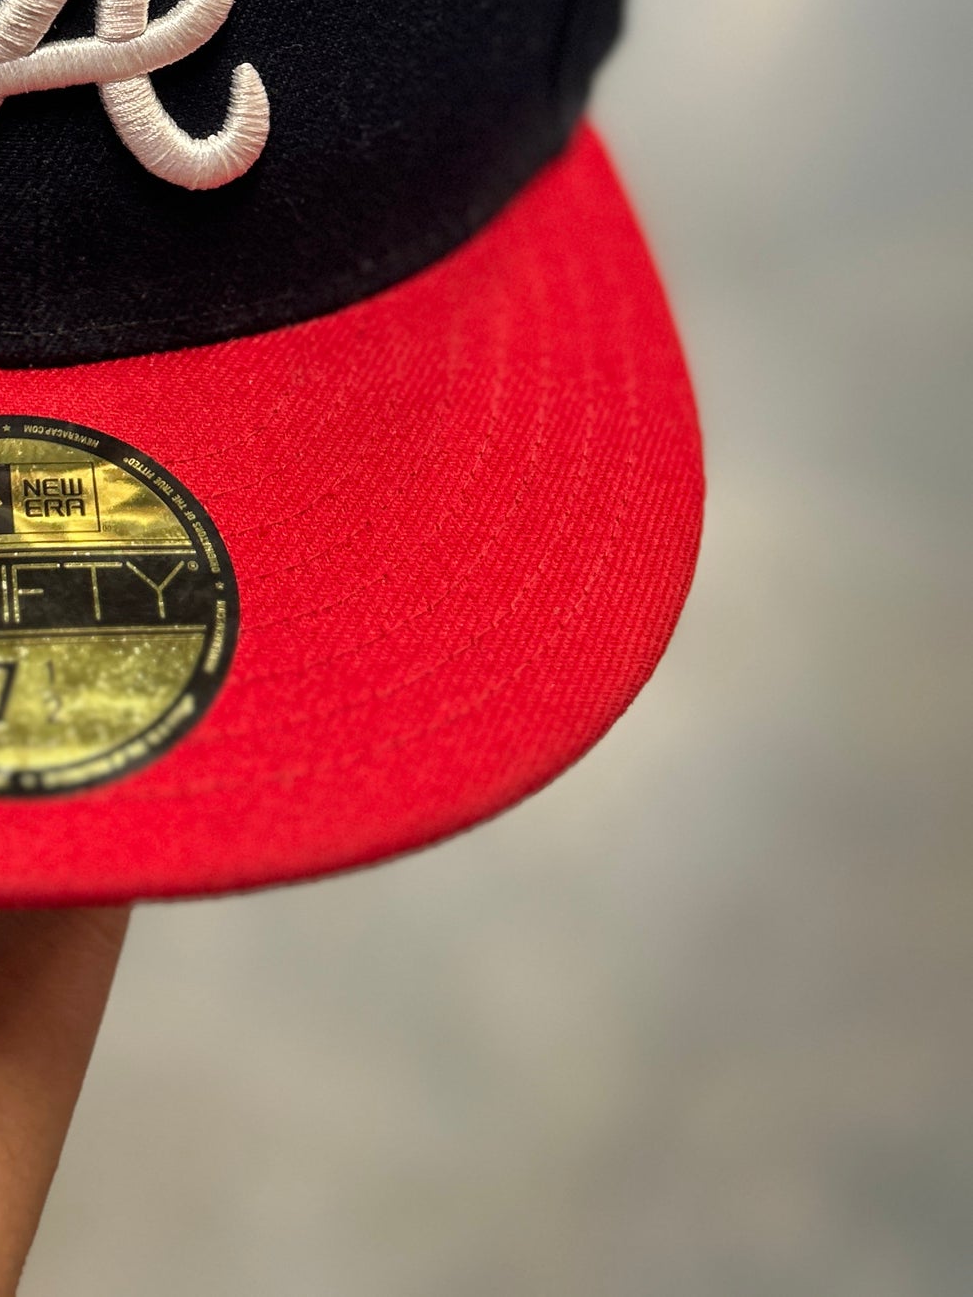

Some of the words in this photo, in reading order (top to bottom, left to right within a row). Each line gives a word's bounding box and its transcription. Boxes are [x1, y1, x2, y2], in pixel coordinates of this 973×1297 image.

[24, 424, 99, 448] NEWERACAP.COM
[22, 478, 83, 497] NEW
[153, 476, 174, 496] TRUE
[23, 498, 87, 518] ERA
[171, 494, 187, 510] THE
[184, 510, 196, 521] OF
